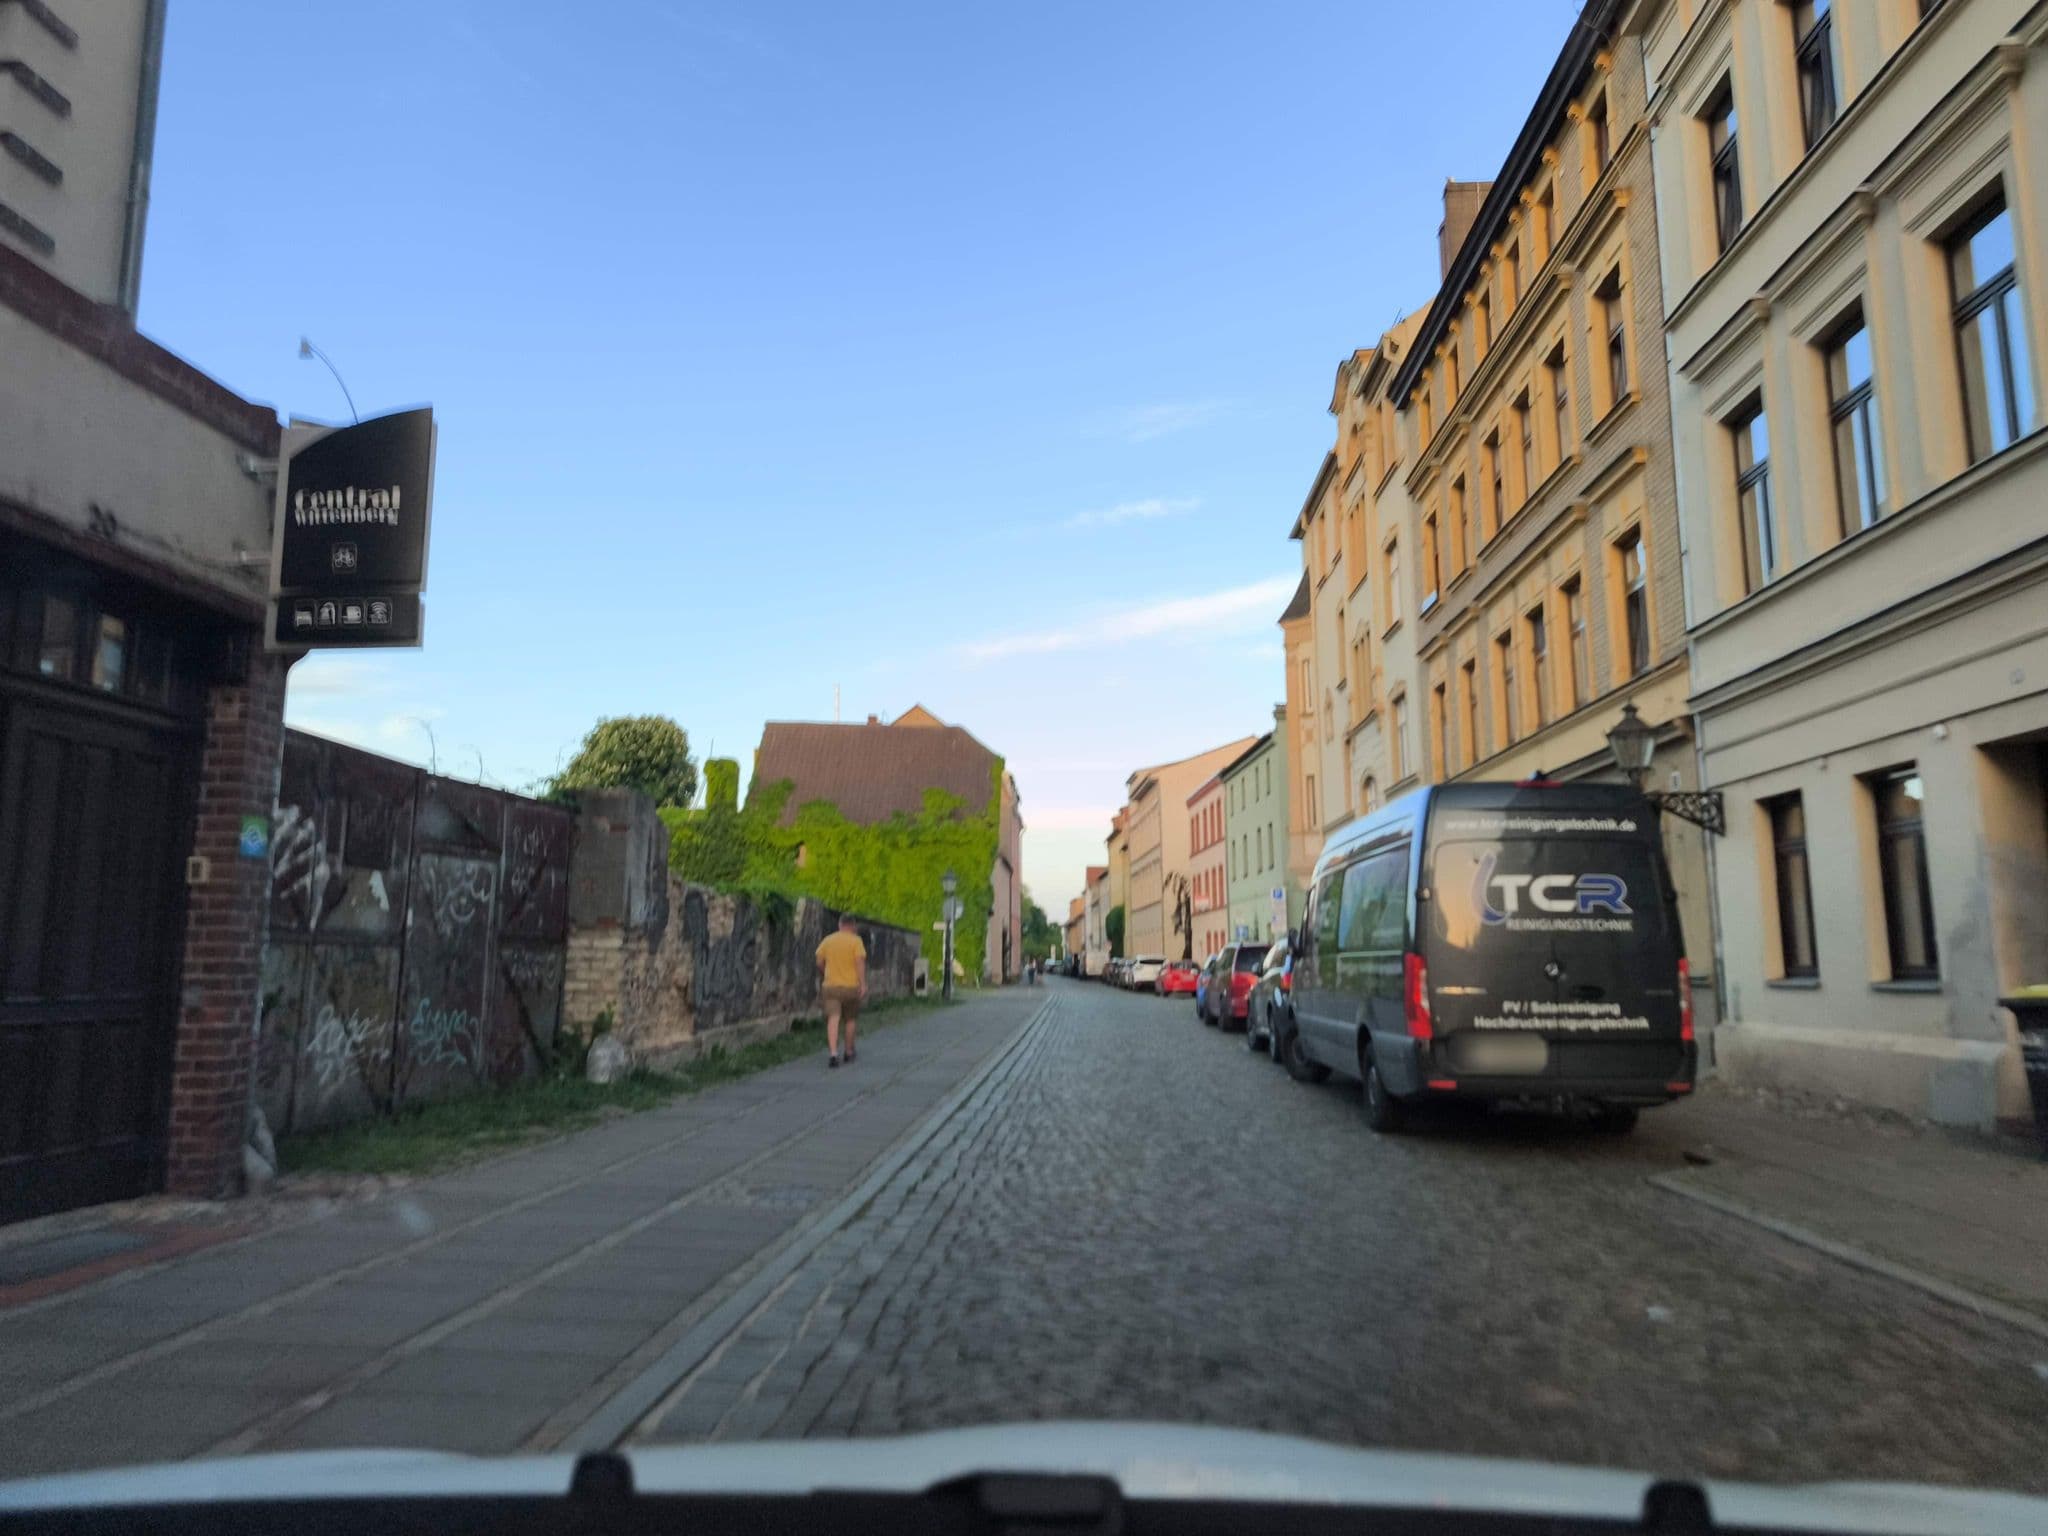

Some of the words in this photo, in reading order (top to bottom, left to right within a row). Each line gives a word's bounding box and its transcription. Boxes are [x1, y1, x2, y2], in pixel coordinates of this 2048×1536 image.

[1490, 873, 1634, 914] TCR
[1506, 918, 1633, 932] REINIGUNGSTECHNIK
[1502, 1001, 1521, 1014] PV
